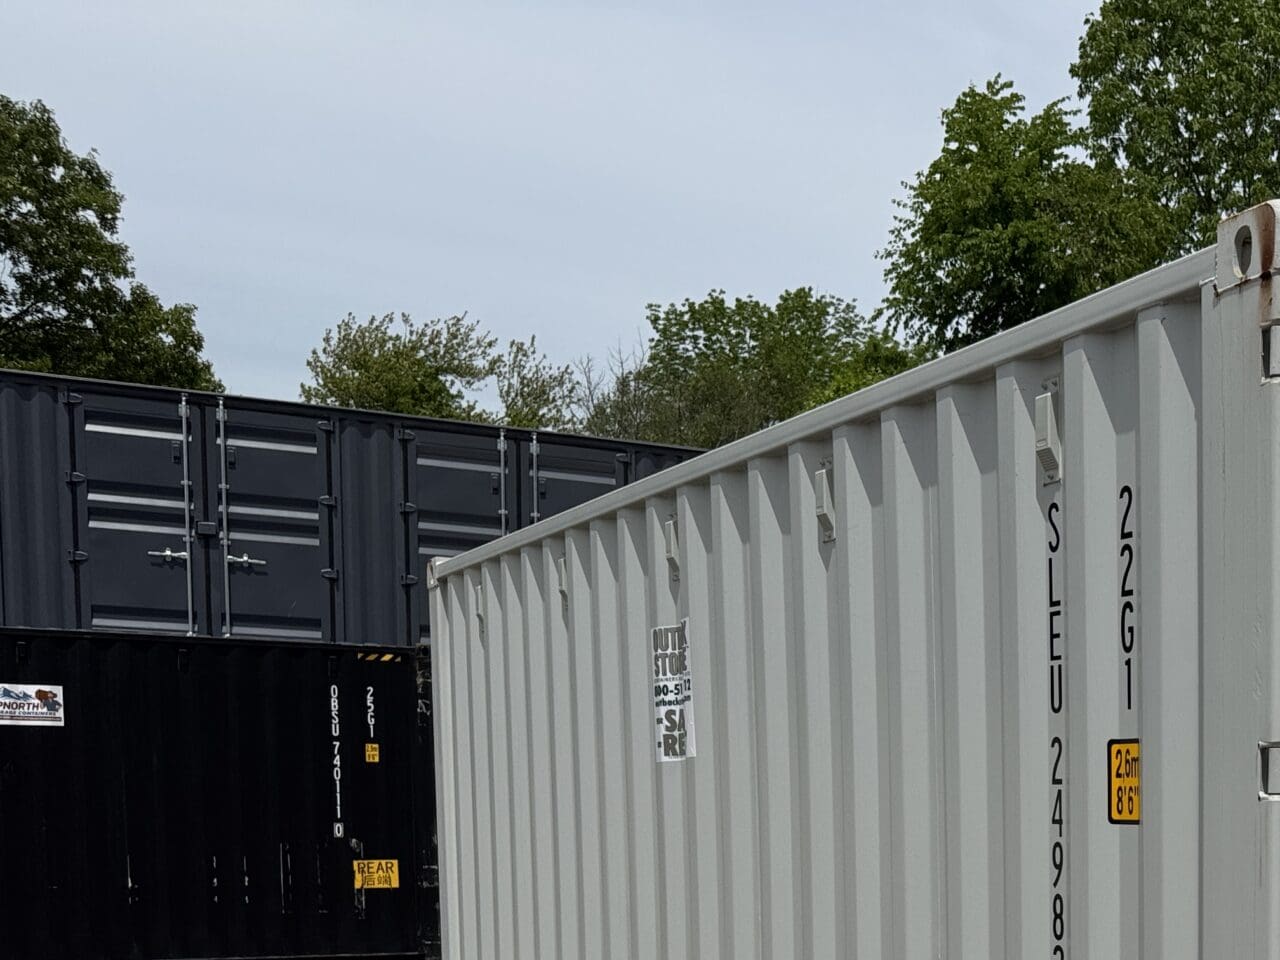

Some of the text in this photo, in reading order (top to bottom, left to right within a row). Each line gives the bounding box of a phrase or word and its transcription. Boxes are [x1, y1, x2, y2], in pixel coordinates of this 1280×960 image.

[1048, 502, 1062, 714] SLEU
[1119, 485, 1135, 710] 22G1
[366, 686, 375, 738] 25G1
[332, 741, 341, 818] 740111
[357, 861, 395, 875] REAR
